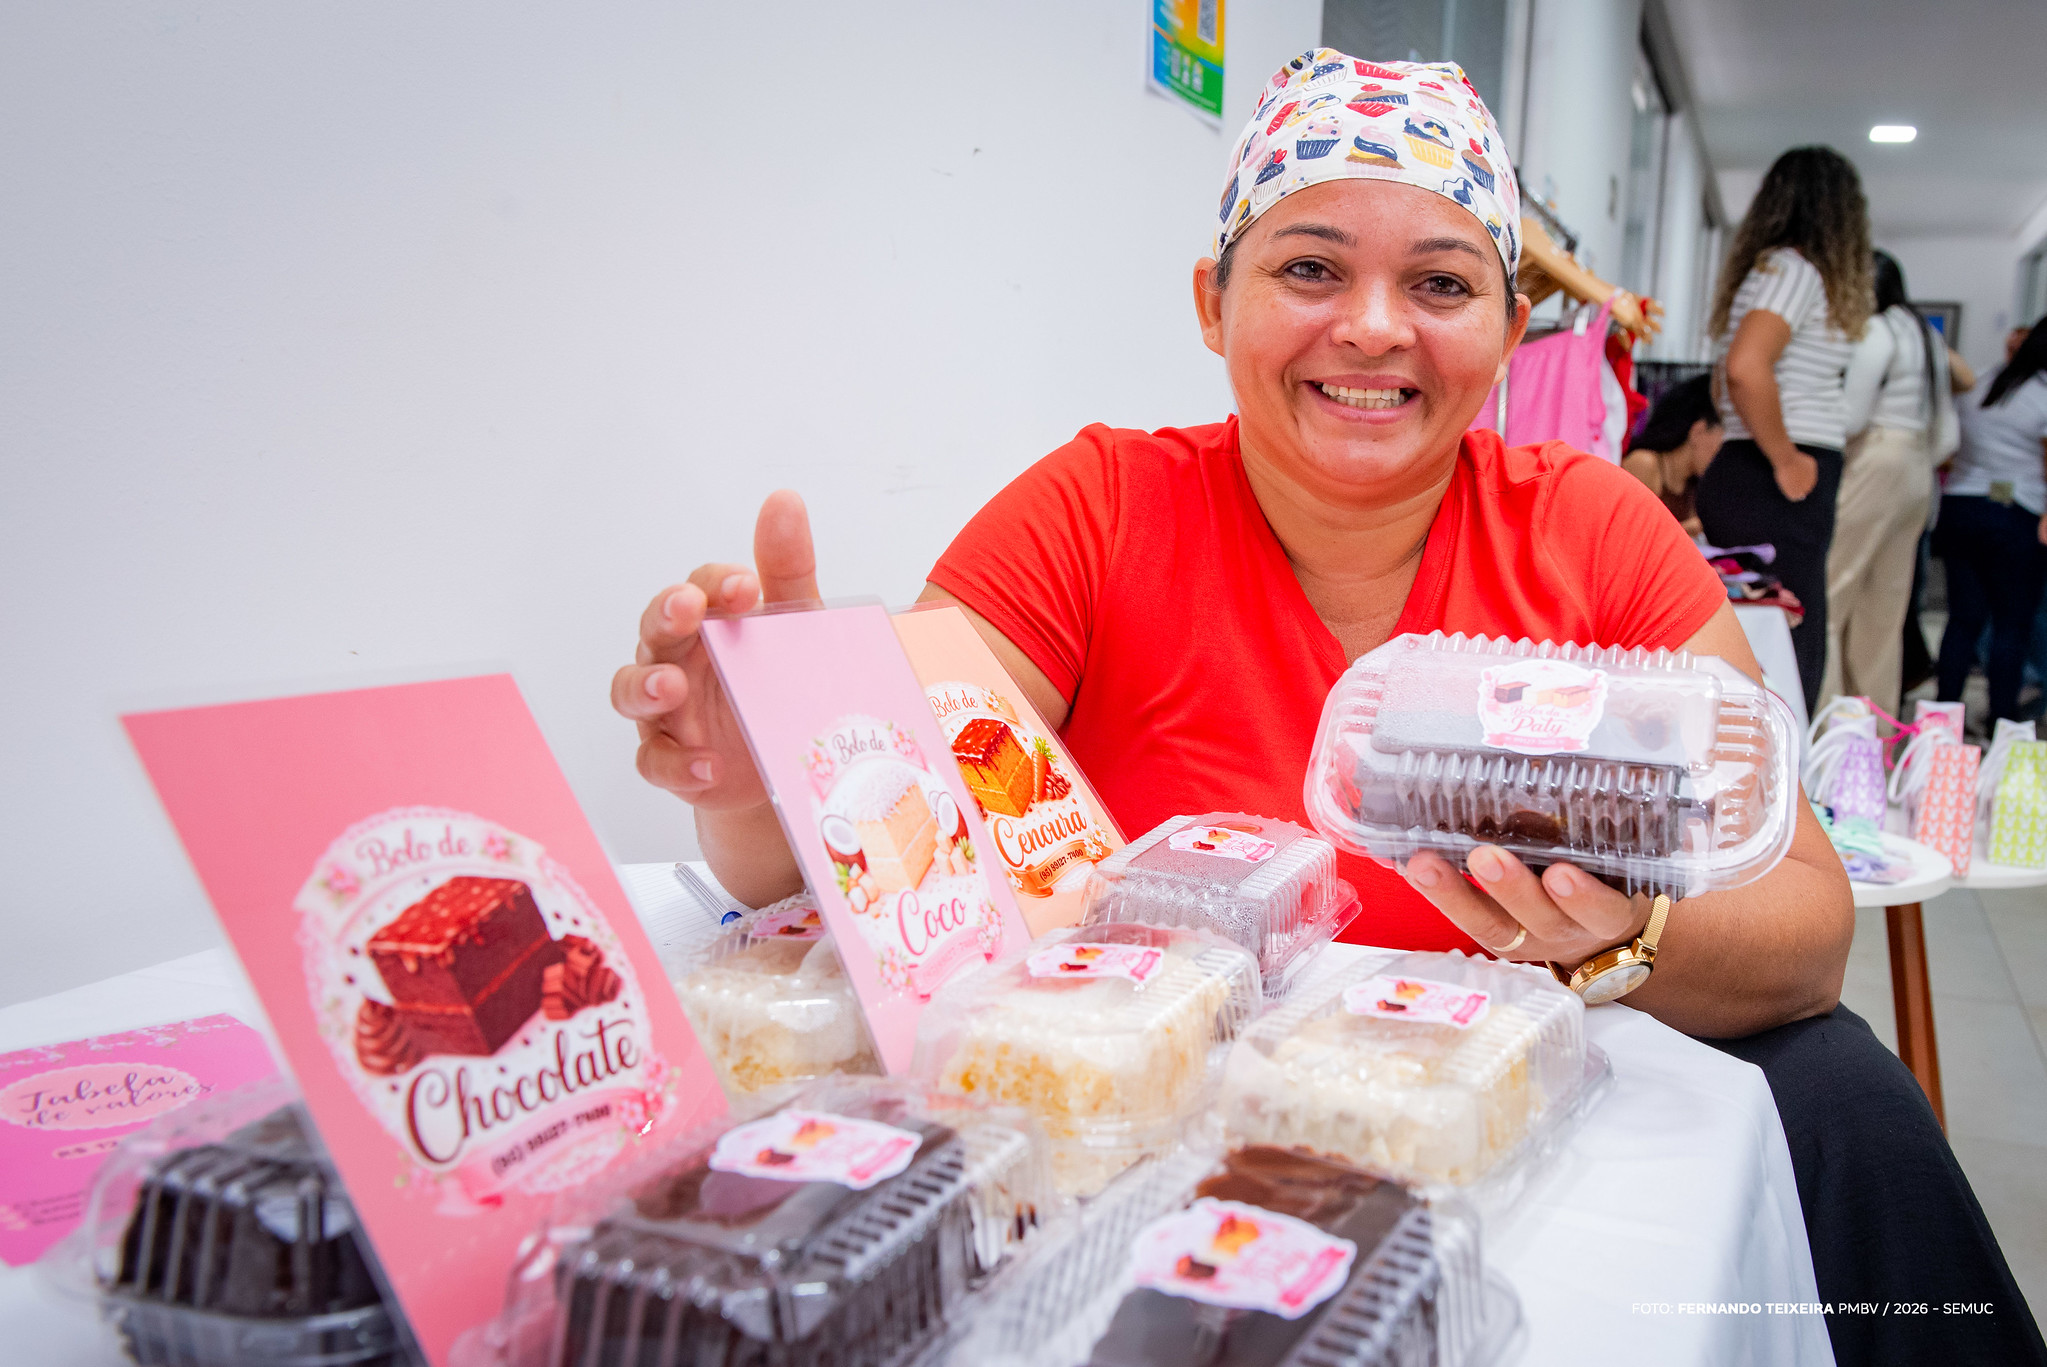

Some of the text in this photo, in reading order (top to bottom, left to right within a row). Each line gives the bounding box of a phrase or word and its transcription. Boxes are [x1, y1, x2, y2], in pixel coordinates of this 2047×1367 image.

[929, 690, 978, 718] Bolo de
[832, 730, 886, 764] Bolo de
[355, 825, 470, 876] Bolo de
[993, 810, 1087, 868] Cenoura
[897, 890, 967, 956] Coco
[19, 1072, 176, 1113] Tabela
[406, 1018, 640, 1163] Chocolate
